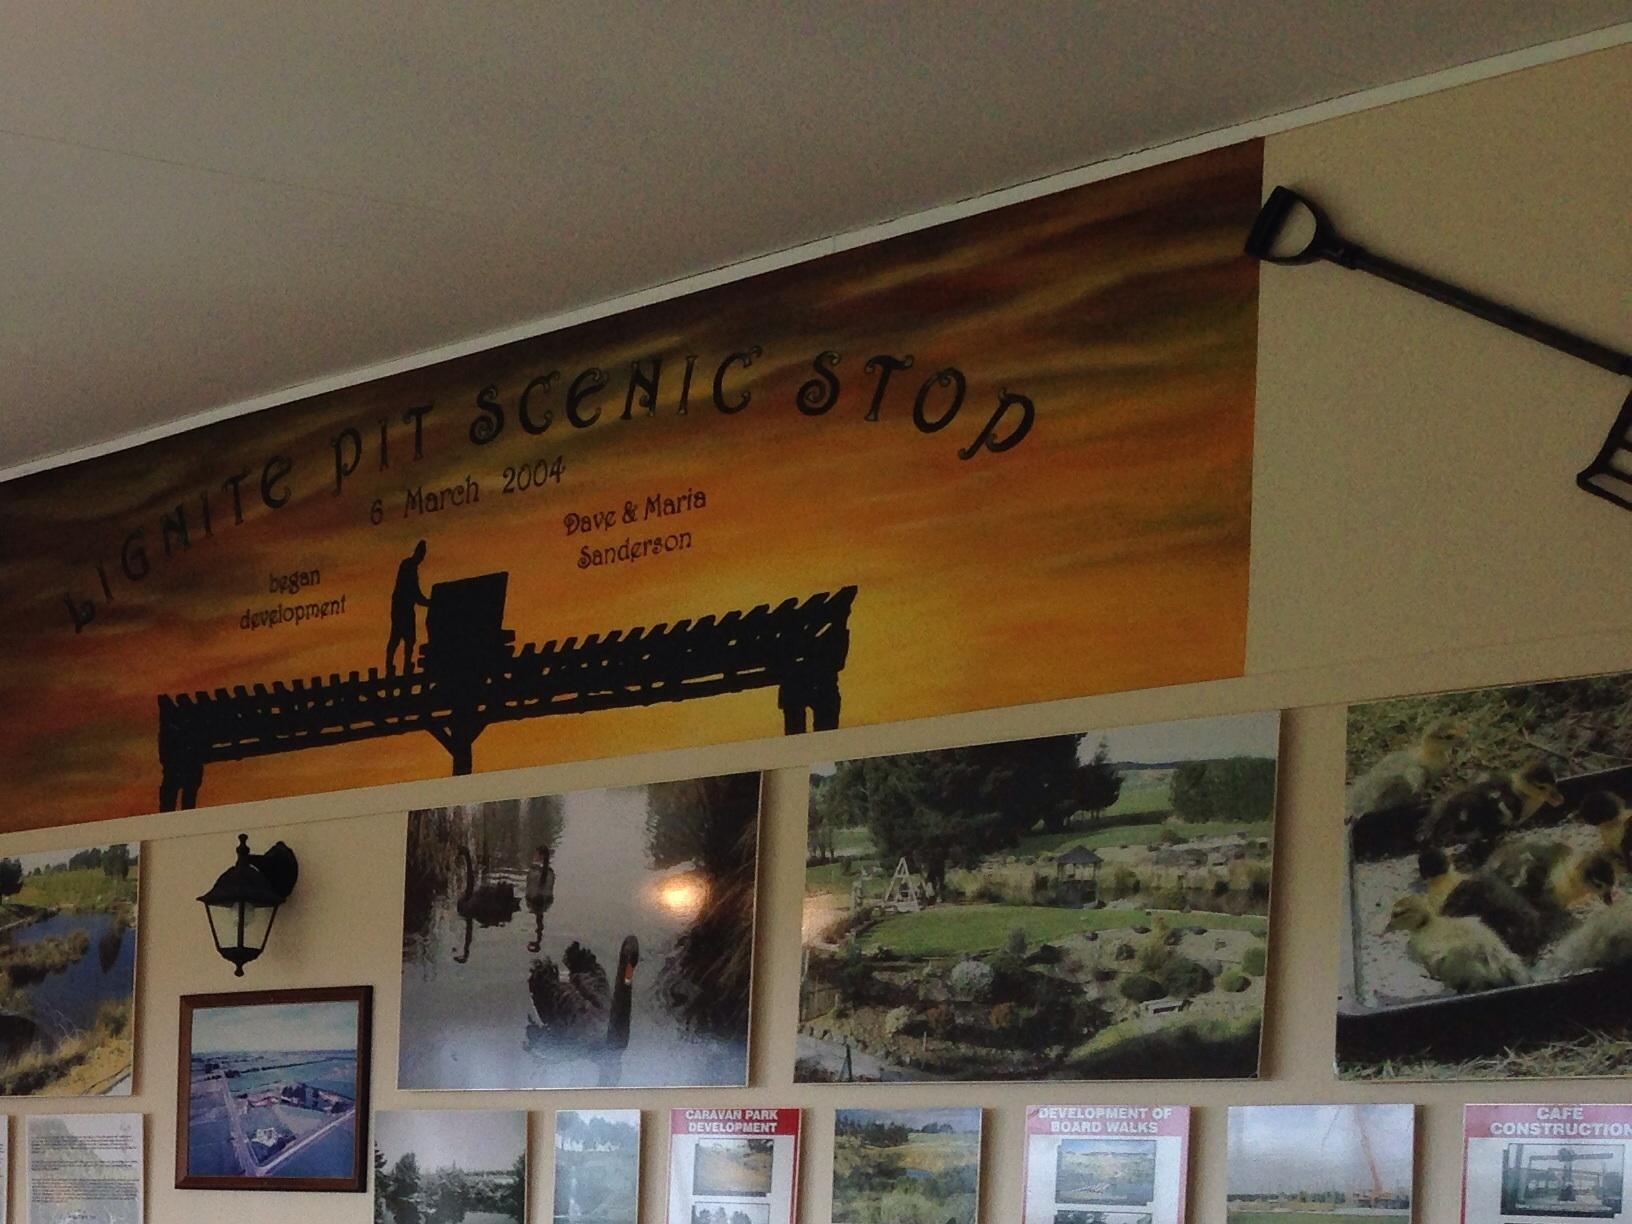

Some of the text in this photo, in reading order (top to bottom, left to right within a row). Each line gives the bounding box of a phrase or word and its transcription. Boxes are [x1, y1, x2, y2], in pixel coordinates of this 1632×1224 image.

[331, 400, 434, 497] PIT
[469, 345, 763, 446] SCENIC
[795, 350, 1036, 460] STOP
[370, 455, 566, 526] 6 March 2004
[563, 487, 707, 536] Dave & Maria
[577, 531, 693, 570] Sanderson
[269, 568, 321, 595] began
[239, 594, 347, 631] development
[685, 1109, 779, 1121] CARAVAN PARK
[688, 1121, 778, 1133] DEVELOPMENT
[1038, 1107, 1173, 1120] DEVELOPMENT OF
[1050, 1121, 1159, 1133] BOARD WALKS
